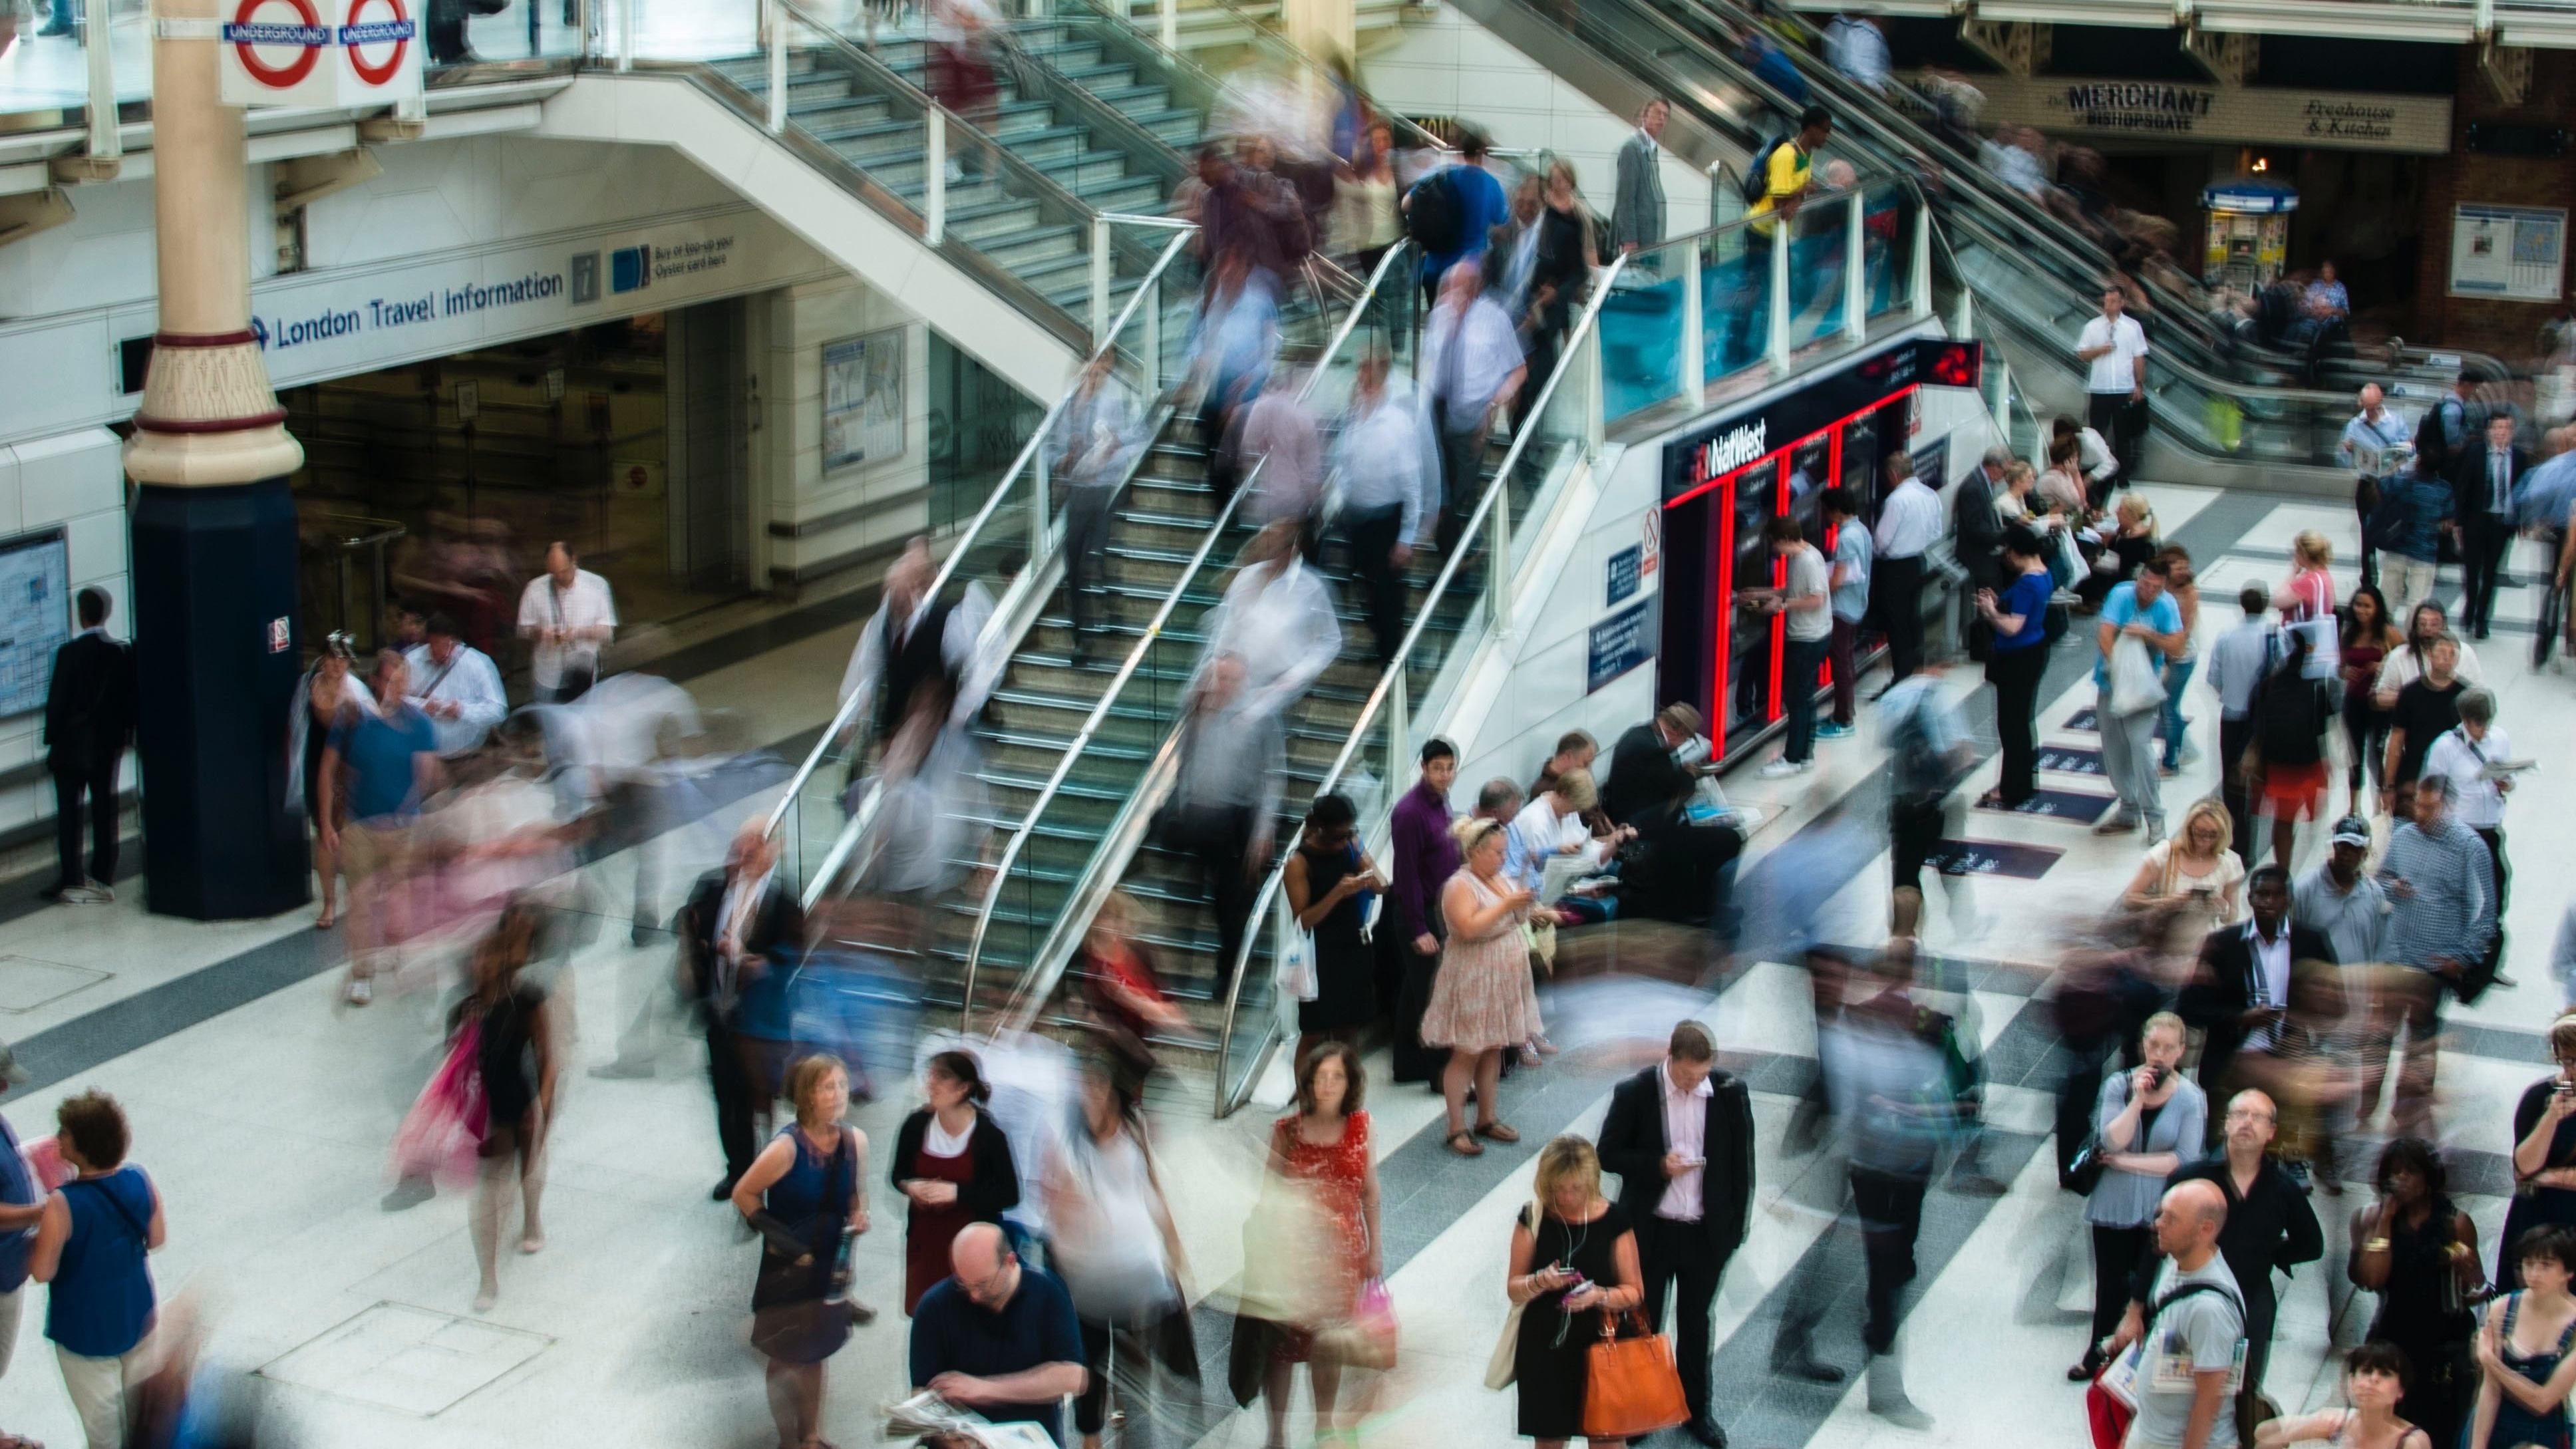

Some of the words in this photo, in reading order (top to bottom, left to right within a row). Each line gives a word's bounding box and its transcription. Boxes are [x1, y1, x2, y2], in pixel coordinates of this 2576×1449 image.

[230, 25, 326, 41] UNDERGROUND
[343, 23, 412, 41] UNDERGROUND
[2068, 82, 2215, 115] MERCHANT
[2306, 100, 2395, 118] Freehouse
[2087, 111, 2193, 130] BISHOPSGATE
[2327, 118, 2392, 136] Kitchen
[277, 308, 361, 347] London
[369, 291, 435, 328] Travel
[446, 271, 564, 315] Information
[1711, 417, 1766, 478] NatWest
